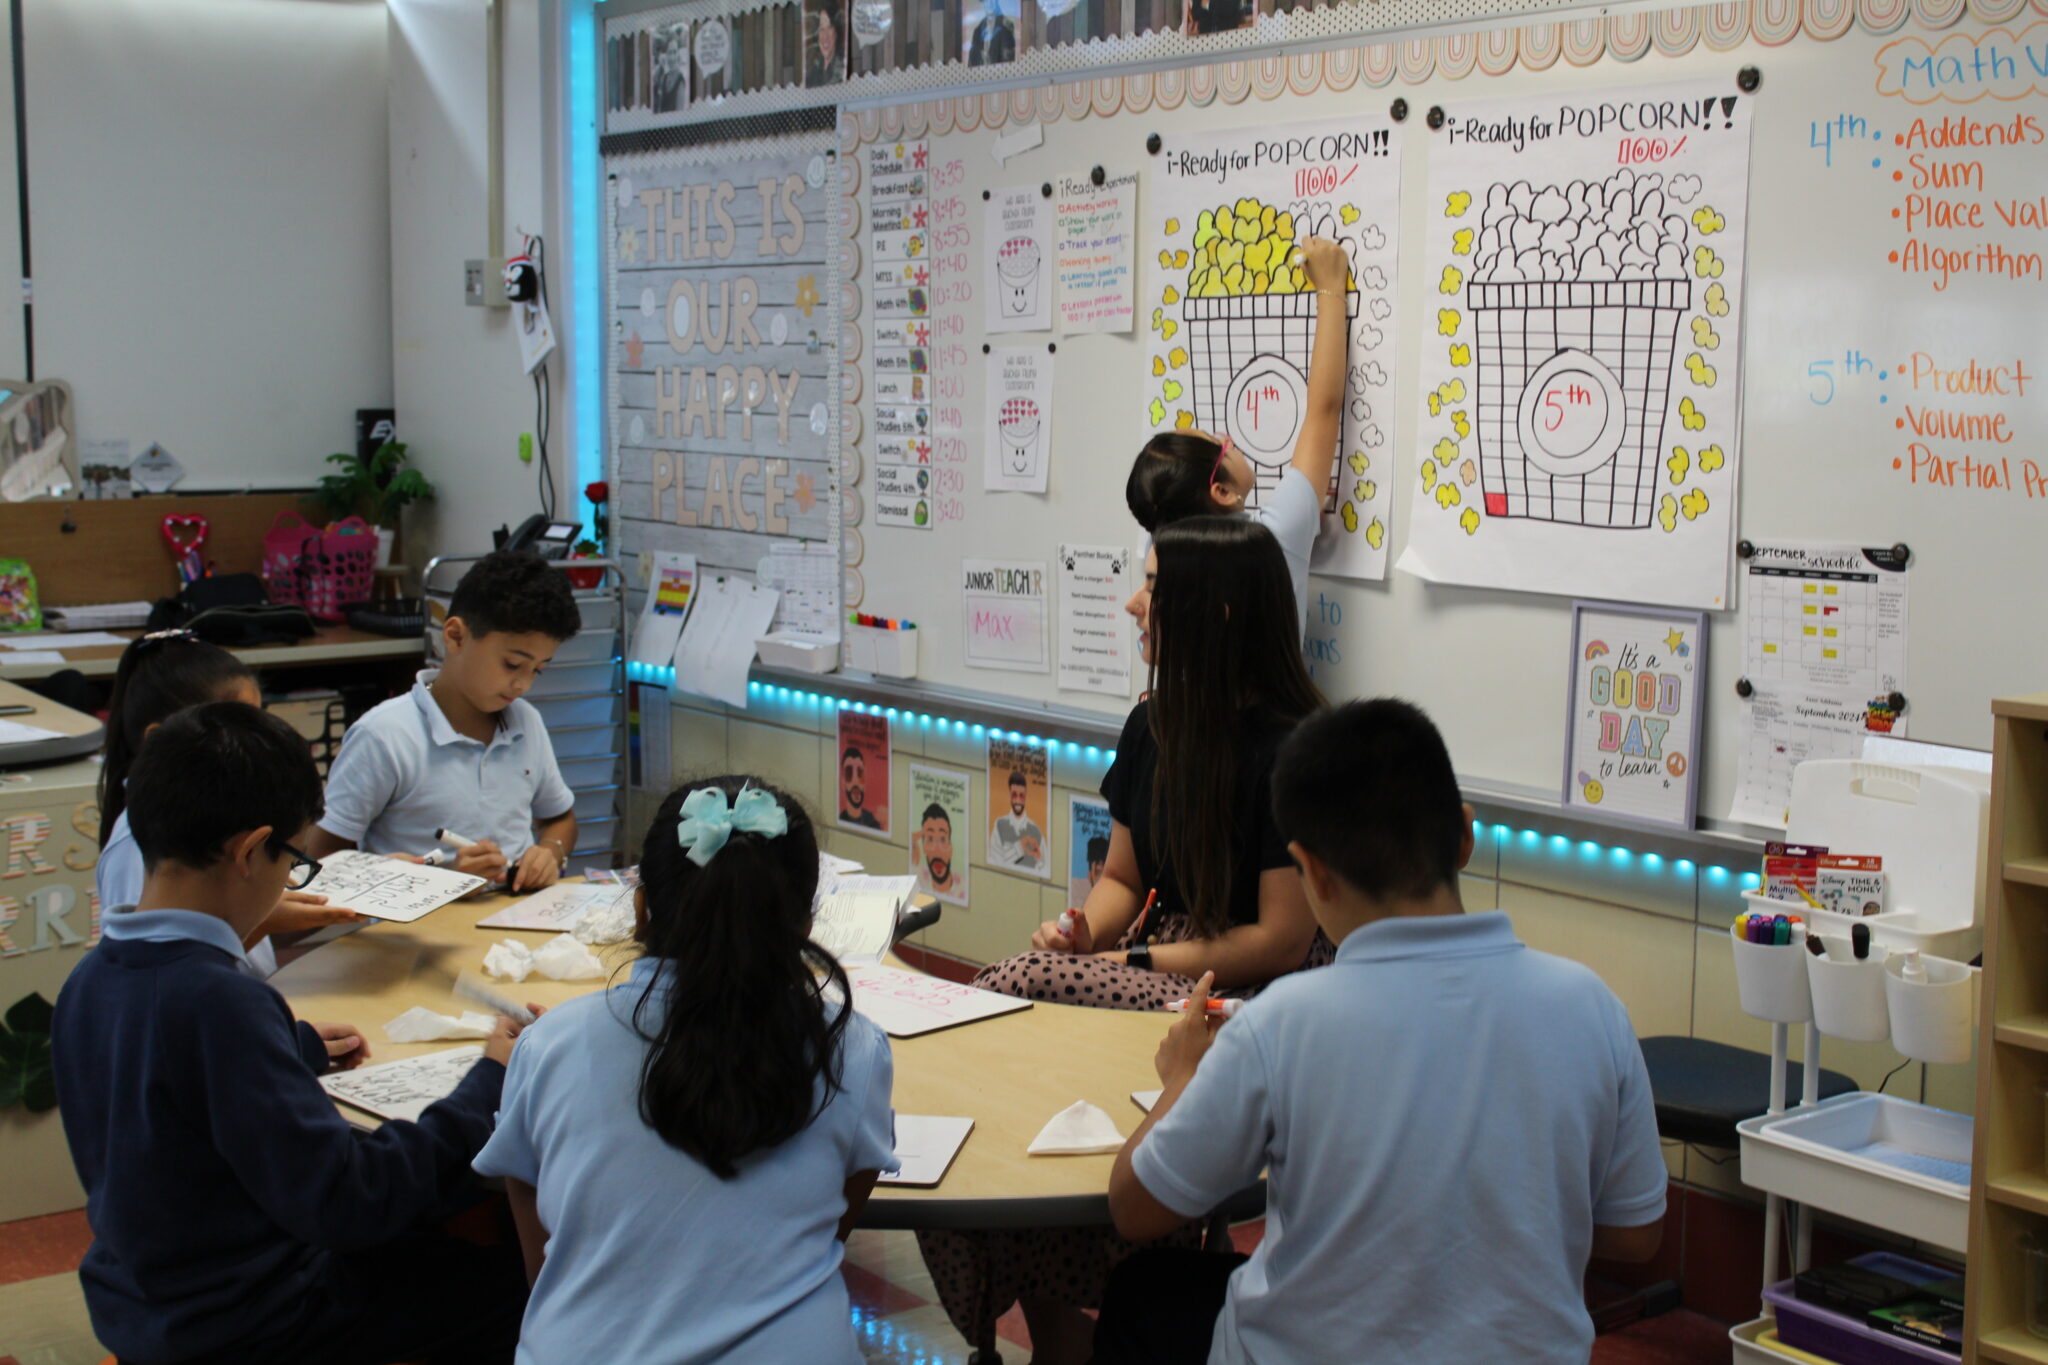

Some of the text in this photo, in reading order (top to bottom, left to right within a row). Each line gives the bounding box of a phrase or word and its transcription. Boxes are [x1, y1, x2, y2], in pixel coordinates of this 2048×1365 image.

[1902, 46, 2016, 88] Math
[1448, 96, 1738, 153] i-Ready for POPCORN!!
[1906, 113, 2045, 150] Addends
[872, 163, 902, 175] Schedule
[1167, 129, 1389, 184] i-Ready for POPCORN!!
[1909, 153, 1984, 191] Sum
[872, 183, 908, 196] Breakfast
[639, 173, 805, 262] THIS IS
[931, 195, 967, 224] 8:45
[1905, 194, 1984, 232] Place
[932, 222, 970, 252] 8:55
[931, 252, 968, 278] 9:40
[1903, 239, 2043, 291] Algorithm
[665, 275, 762, 355] OUR
[876, 330, 900, 341] Switch
[877, 383, 898, 394] Lunch
[1910, 351, 2033, 397] Product
[655, 364, 800, 447] HAPPY
[1246, 385, 1280, 431] 4th
[1544, 384, 1592, 432] 5th
[1905, 405, 2014, 443] Volume
[878, 444, 901, 456] Switch
[1908, 442, 2048, 499] Partial Pr
[652, 450, 790, 534] PLACE
[877, 503, 908, 517] Dismissal
[965, 570, 995, 591] JUNIOR
[975, 610, 1015, 641] Max
[1317, 592, 1342, 626] to
[1618, 642, 1661, 669] It's a
[1590, 665, 1681, 716] GOOD
[1796, 706, 1860, 722] September 2024
[1599, 711, 1670, 760] DAY
[1600, 755, 1661, 779] to learn
[1822, 875, 1846, 887] Disney
[1848, 886, 1881, 894] MONEY
